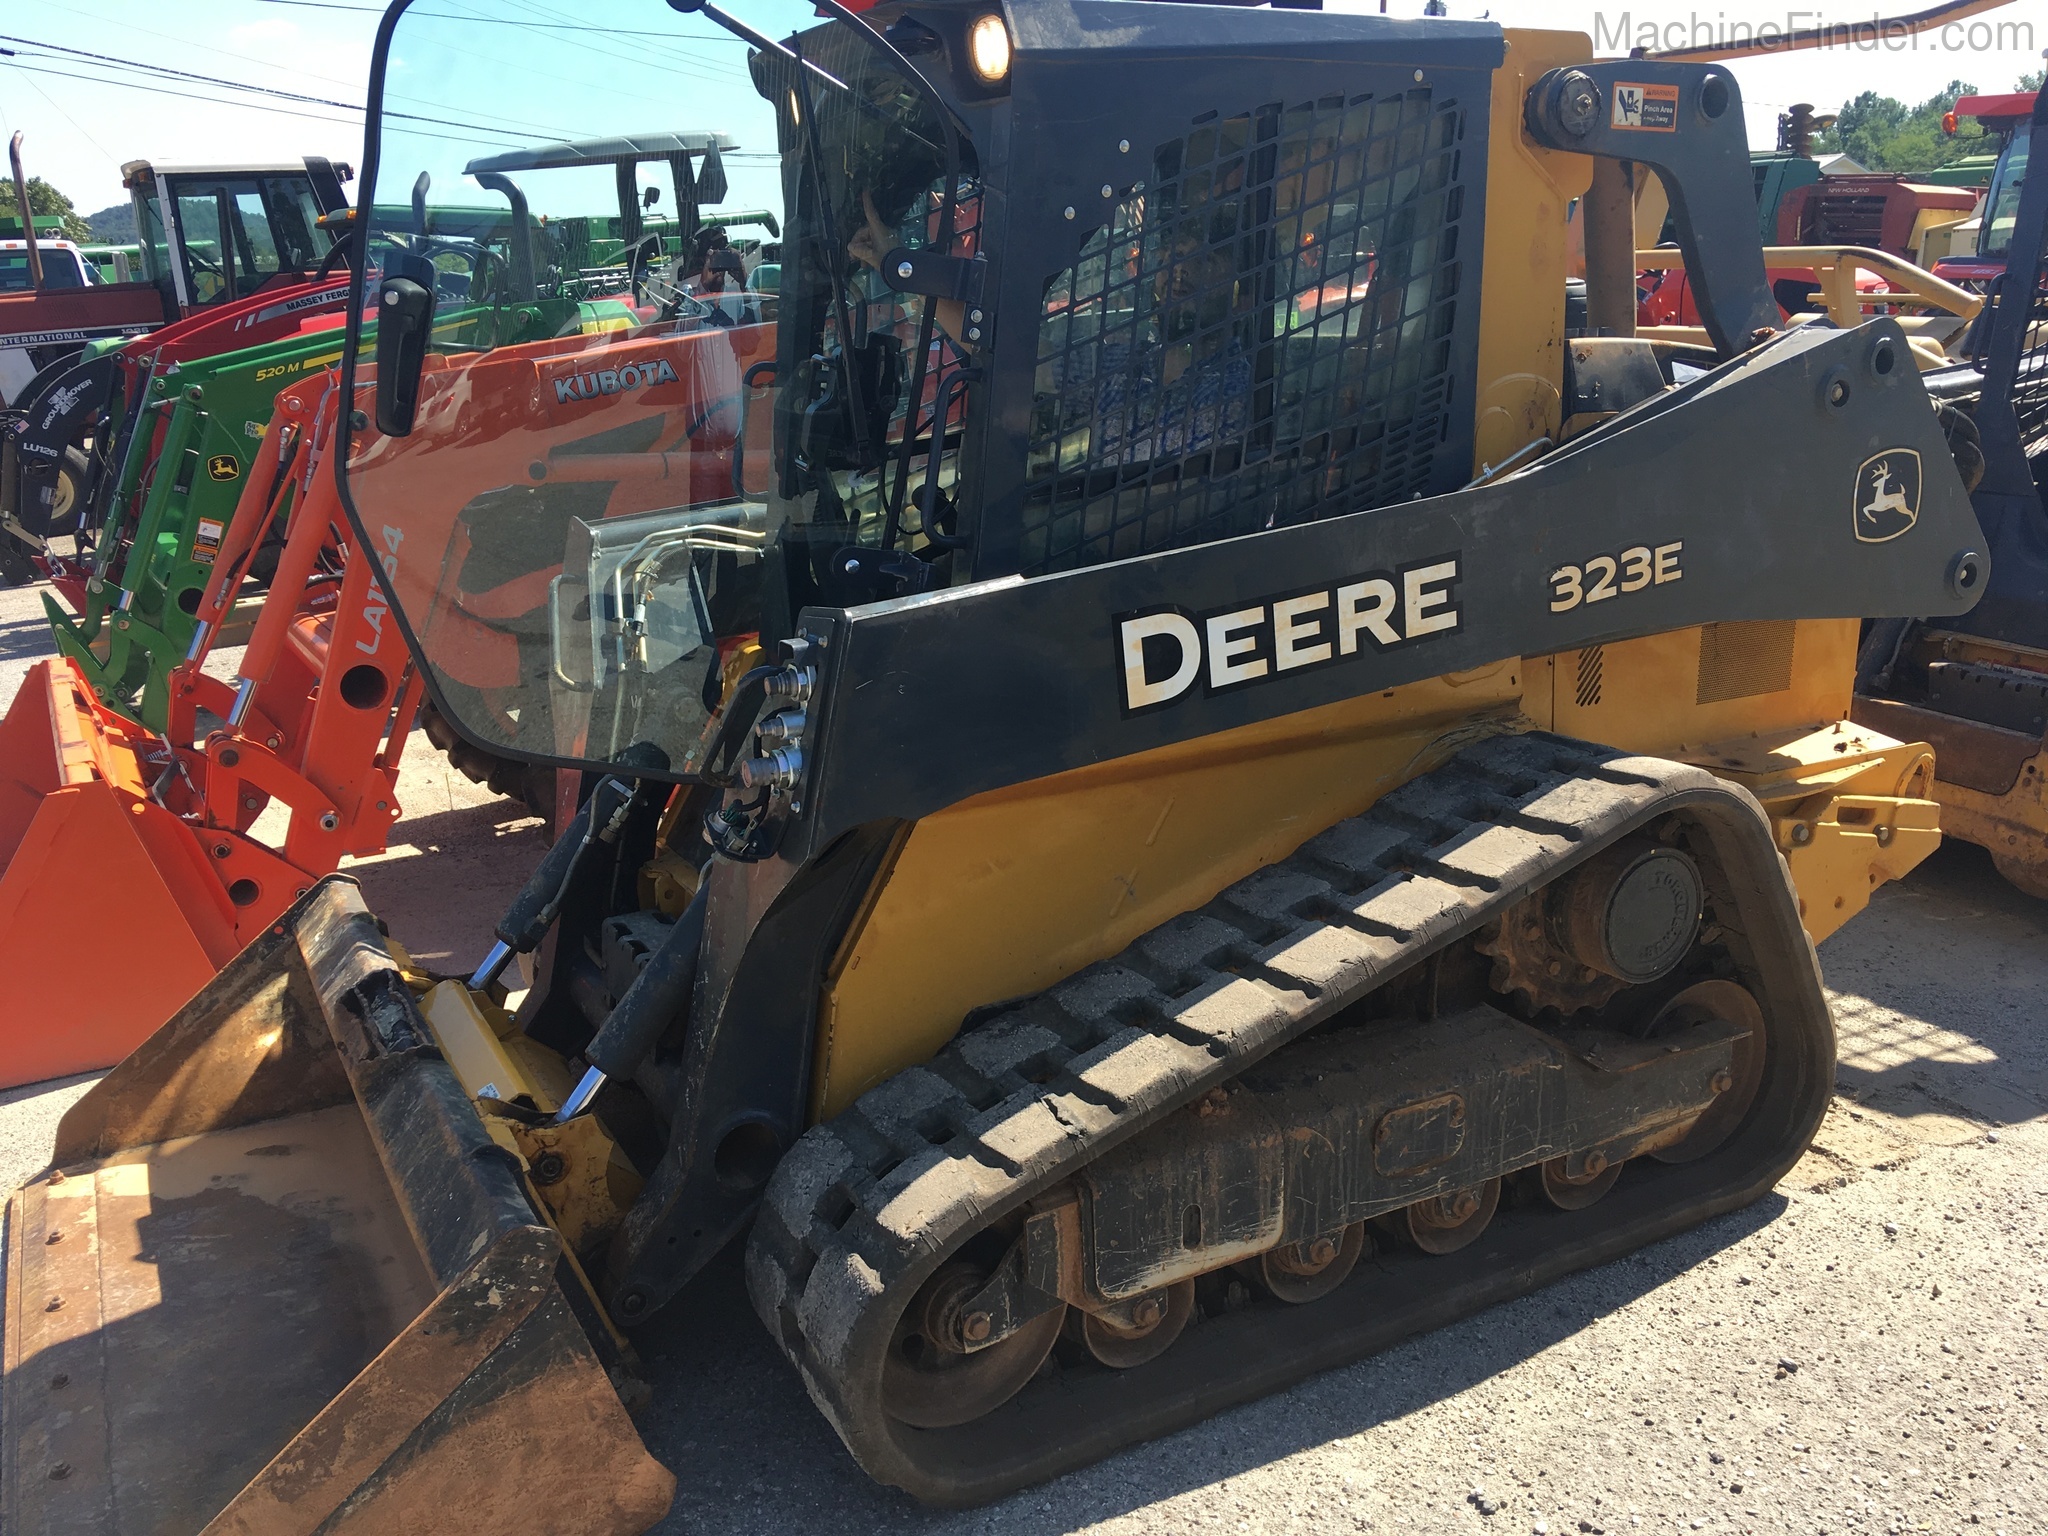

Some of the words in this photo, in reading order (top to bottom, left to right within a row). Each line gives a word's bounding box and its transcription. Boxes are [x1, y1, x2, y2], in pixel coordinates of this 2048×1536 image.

[1644, 104, 1660, 113] Pinch
[1660, 105, 1673, 114] Area
[286, 295, 323, 311] MASSEY
[0, 331, 87, 345] NTERNATIONAL
[255, 365, 285, 382] 520
[287, 362, 300, 373] M
[553, 358, 680, 405] KUBOTA
[41, 378, 93, 430] GROUNDMOVER
[23, 442, 59, 457] LU126
[1549, 541, 1684, 613] 323E
[1120, 560, 1458, 710] DEERE
